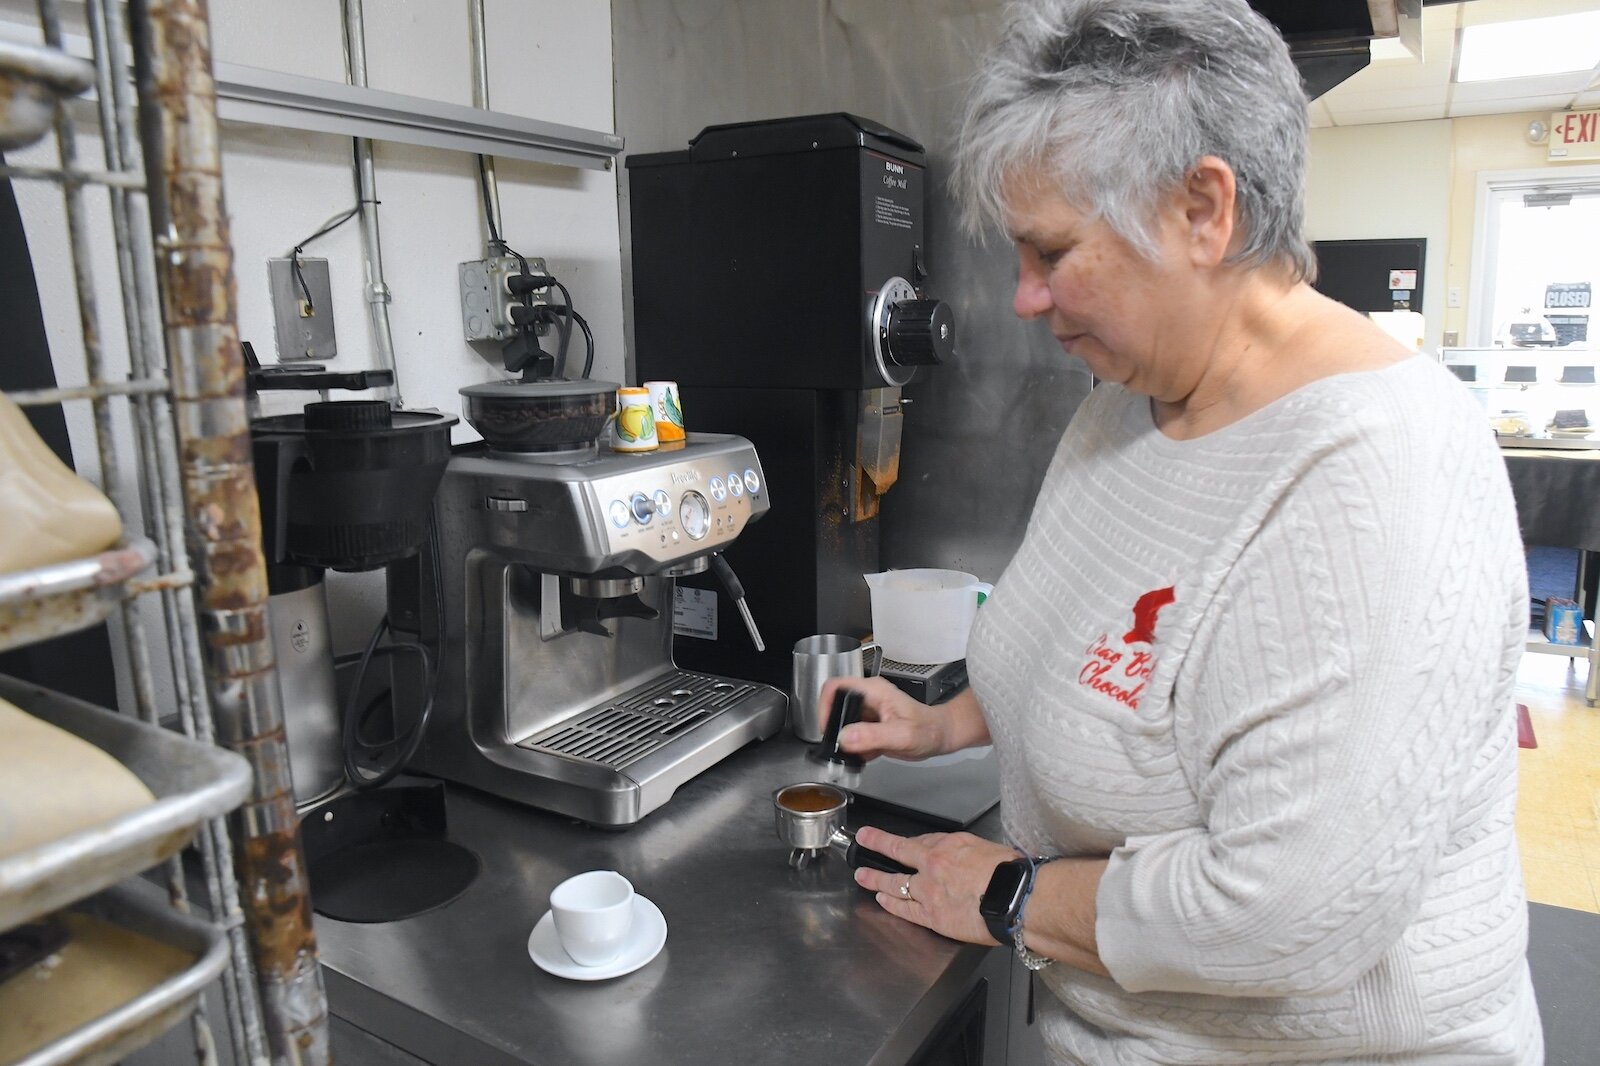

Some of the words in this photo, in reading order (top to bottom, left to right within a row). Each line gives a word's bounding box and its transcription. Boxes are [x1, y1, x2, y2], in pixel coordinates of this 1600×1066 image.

[1563, 113, 1600, 143] EXI
[885, 162, 904, 175] BUNN
[882, 174, 897, 189] Coffee
[897, 178, 907, 189] Mill
[1546, 291, 1590, 307] CLOSED
[1085, 634, 1122, 663] Ciao
